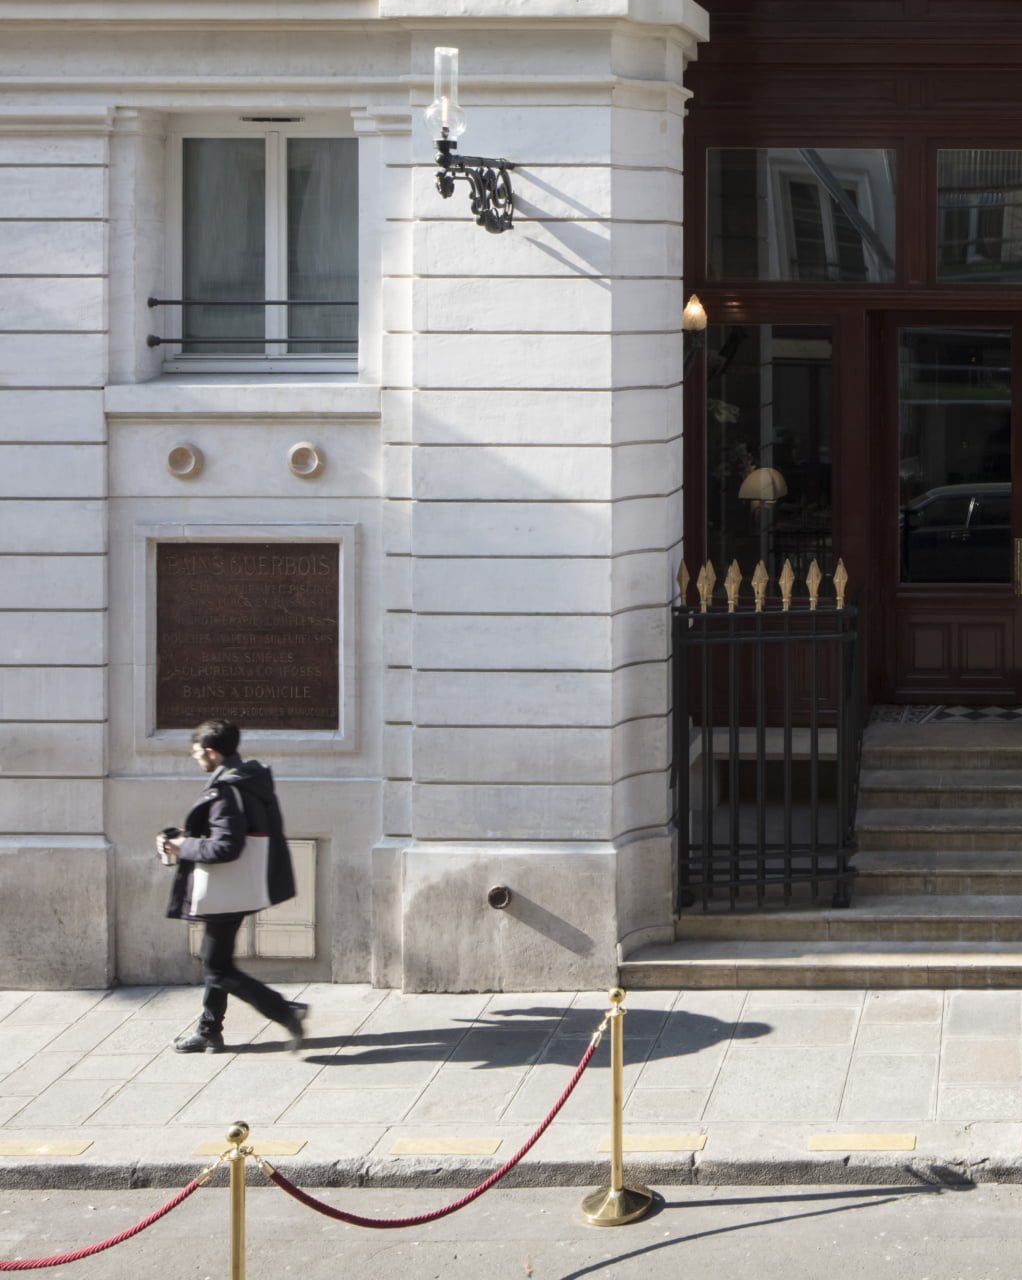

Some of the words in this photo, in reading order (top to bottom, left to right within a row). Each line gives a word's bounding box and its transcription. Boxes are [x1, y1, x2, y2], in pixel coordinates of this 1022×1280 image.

[164, 556, 224, 576] BAINS
[229, 554, 329, 577] GUERBOIS
[183, 684, 225, 699] BAINS
[244, 684, 312, 699] DOMICILE
